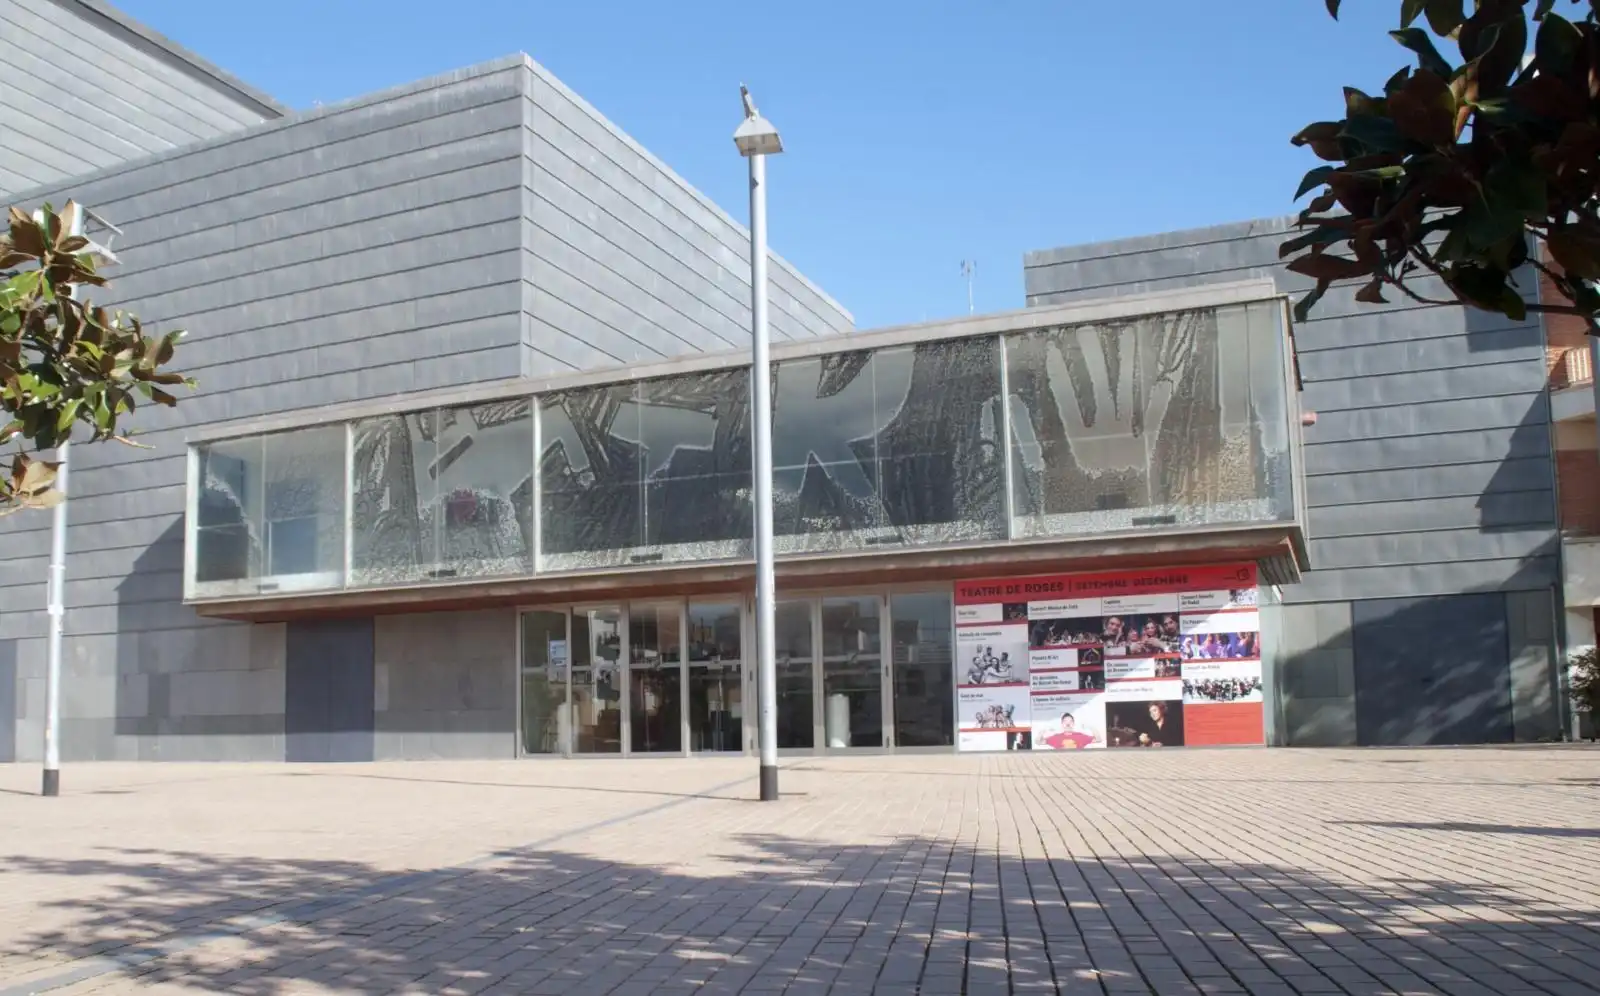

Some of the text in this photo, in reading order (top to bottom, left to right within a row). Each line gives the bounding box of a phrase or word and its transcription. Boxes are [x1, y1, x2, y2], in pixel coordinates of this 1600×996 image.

[960, 585, 1003, 597] TEATRE
[1006, 584, 1021, 596] DE
[1025, 581, 1064, 593] ROSES
[1075, 579, 1127, 590] SETEMBRE
